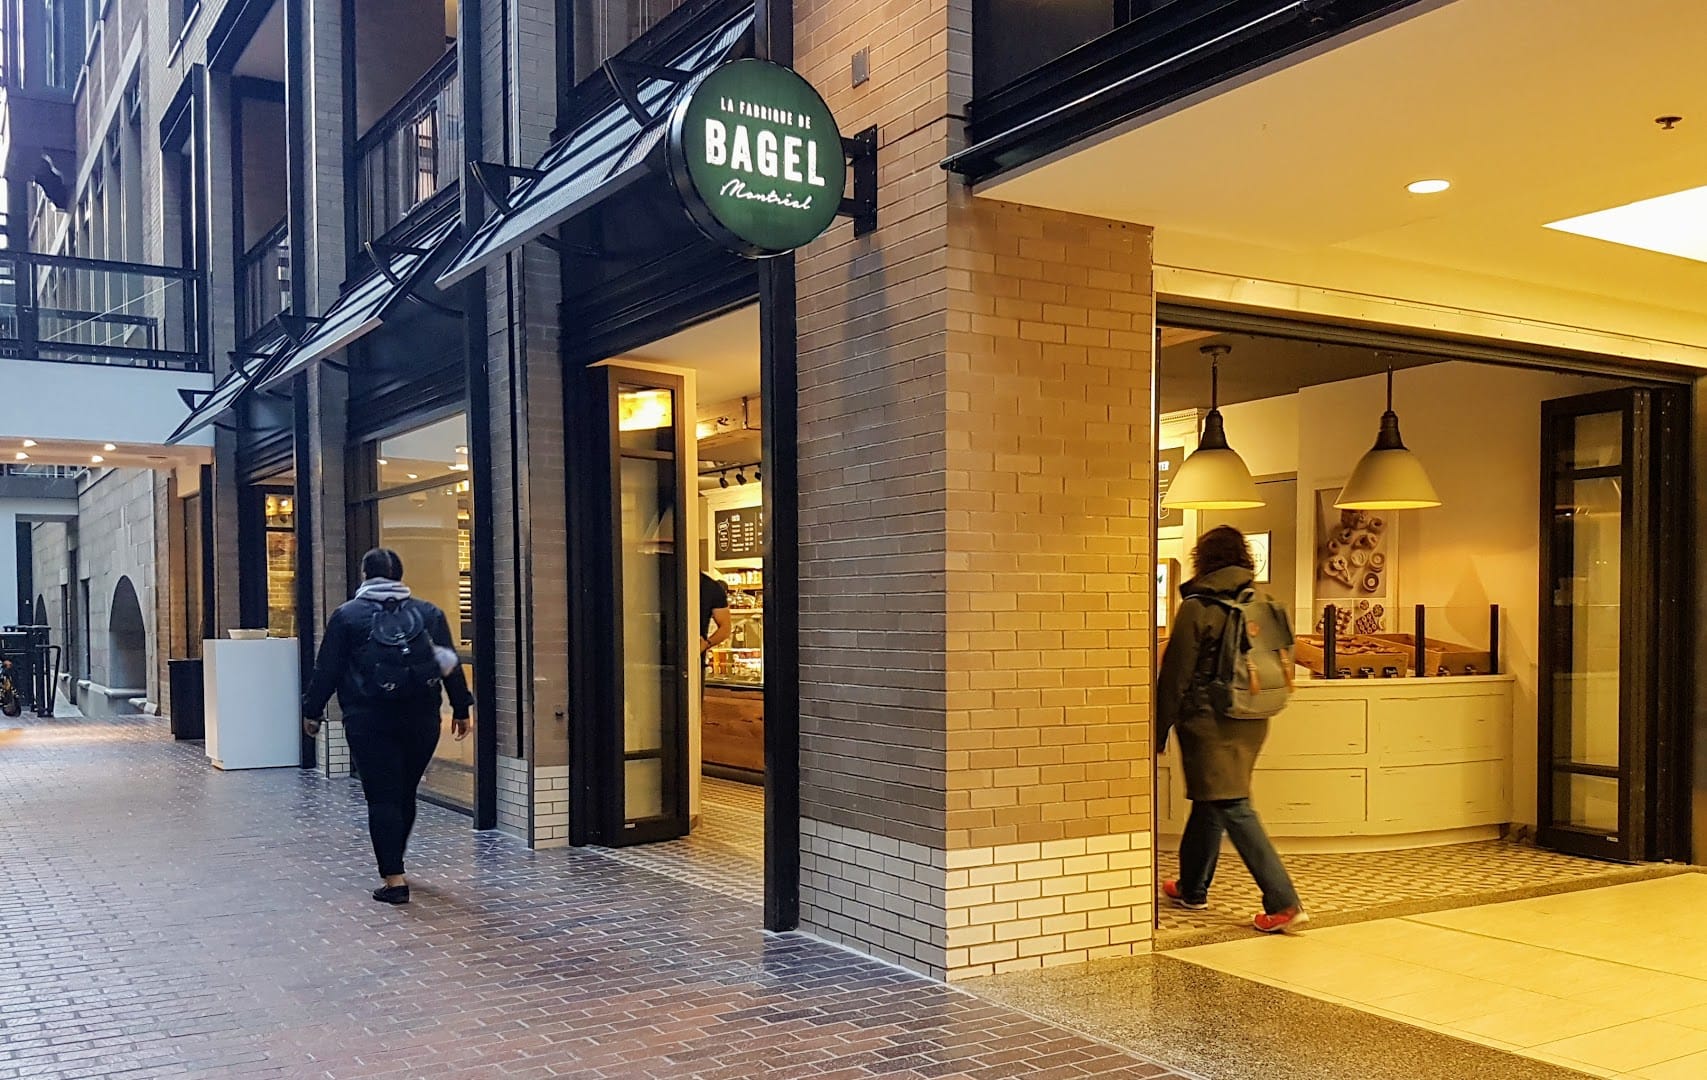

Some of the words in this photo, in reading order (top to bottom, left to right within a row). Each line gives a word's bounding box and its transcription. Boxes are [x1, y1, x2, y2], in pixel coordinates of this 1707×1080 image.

[720, 97, 734, 113] LA
[739, 100, 793, 126] FABRIQUE
[798, 114, 811, 129] DE
[705, 118, 825, 187] BAGEL
[719, 178, 812, 210] Montréal
